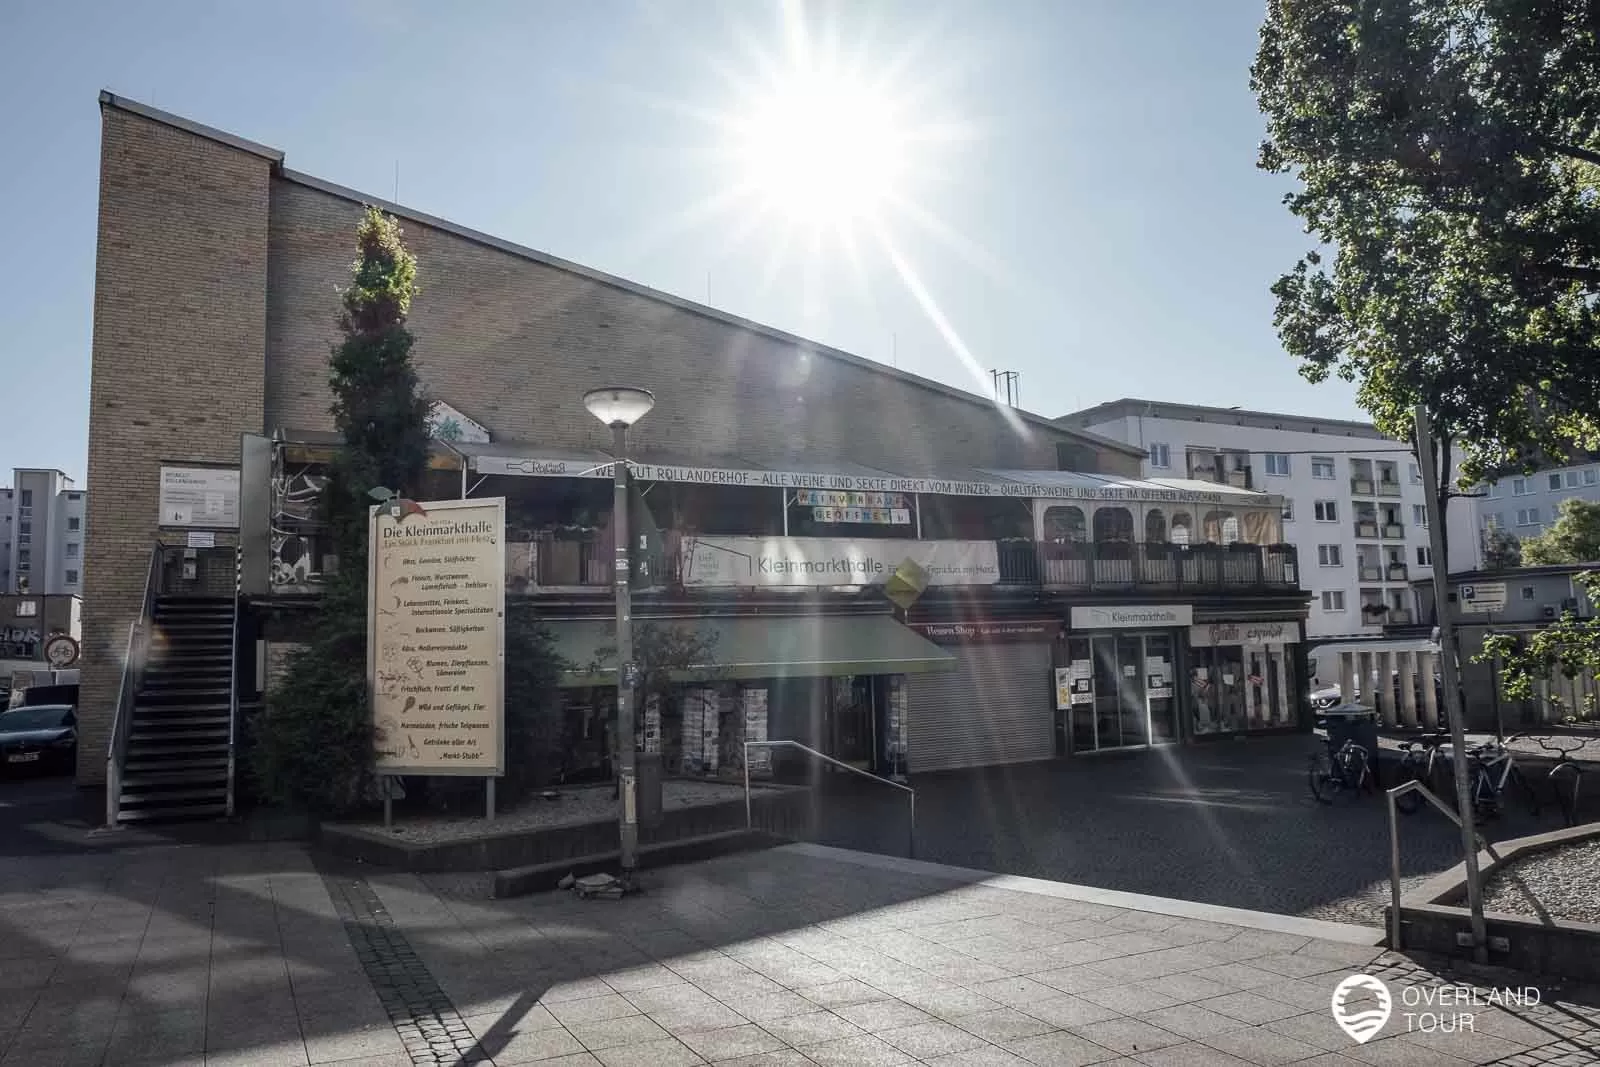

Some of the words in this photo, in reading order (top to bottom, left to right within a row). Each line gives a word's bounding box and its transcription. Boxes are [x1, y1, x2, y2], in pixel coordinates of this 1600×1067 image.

[762, 472, 788, 486] ALLE
[791, 473, 825, 488] WEINE
[830, 475, 852, 489] UND
[856, 477, 886, 490] SEKTE
[890, 479, 925, 492] DIREKT
[929, 480, 951, 493] VOM
[955, 482, 990, 495] WINZER
[1077, 487, 1096, 499] UND
[1100, 487, 1122, 499] SEKTE
[1127, 488, 1138, 499] IM
[383, 527, 402, 538] Die
[405, 521, 493, 538] Kleinmarkthalle
[420, 536, 455, 546] Frankfurt
[757, 556, 883, 574] Kleinmarkthalle
[1111, 609, 1177, 622] Kleinmarkthalle
[418, 703, 432, 711] Wild
[432, 703, 444, 711] und
